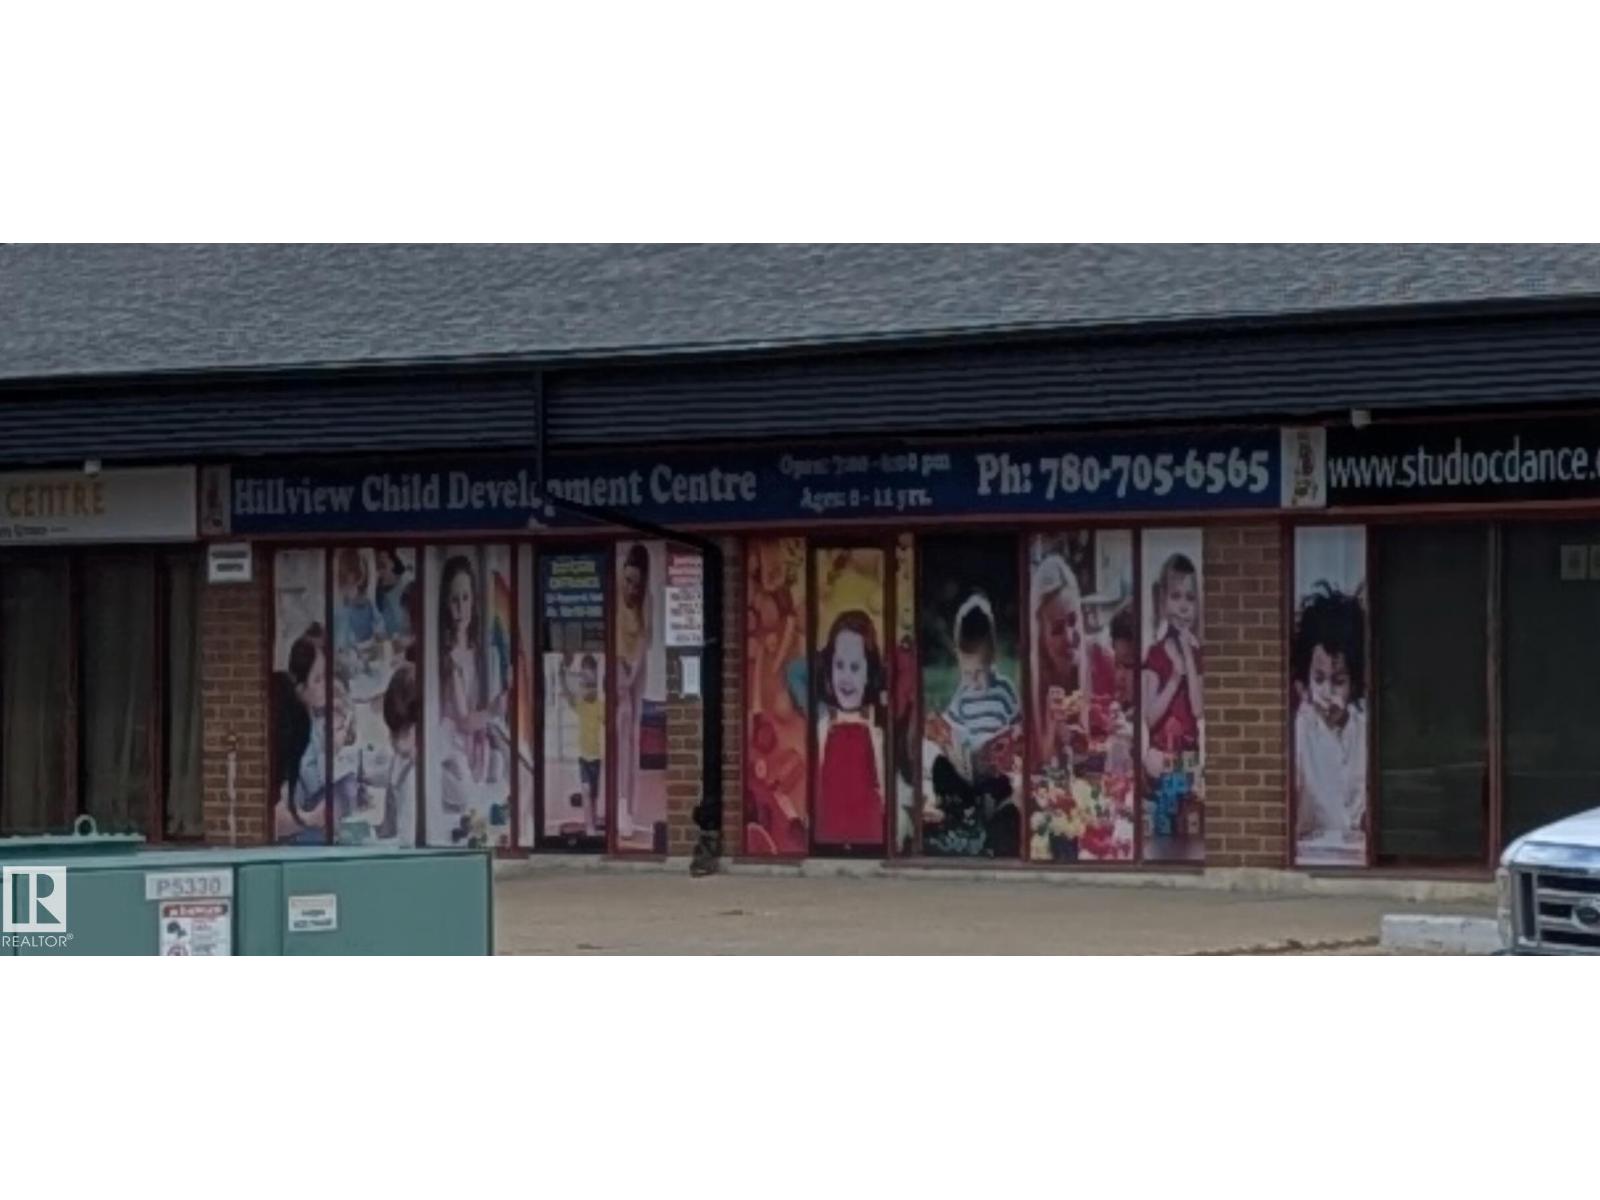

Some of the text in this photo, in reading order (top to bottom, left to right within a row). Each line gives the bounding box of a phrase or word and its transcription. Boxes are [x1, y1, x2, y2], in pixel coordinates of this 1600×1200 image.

[234, 476, 355, 515] Hillview
[361, 471, 439, 512] Child
[649, 463, 757, 504] Centre
[976, 453, 1032, 496] Ph:
[1039, 446, 1270, 501] 780-705-6565
[156, 876, 222, 896] P5330
